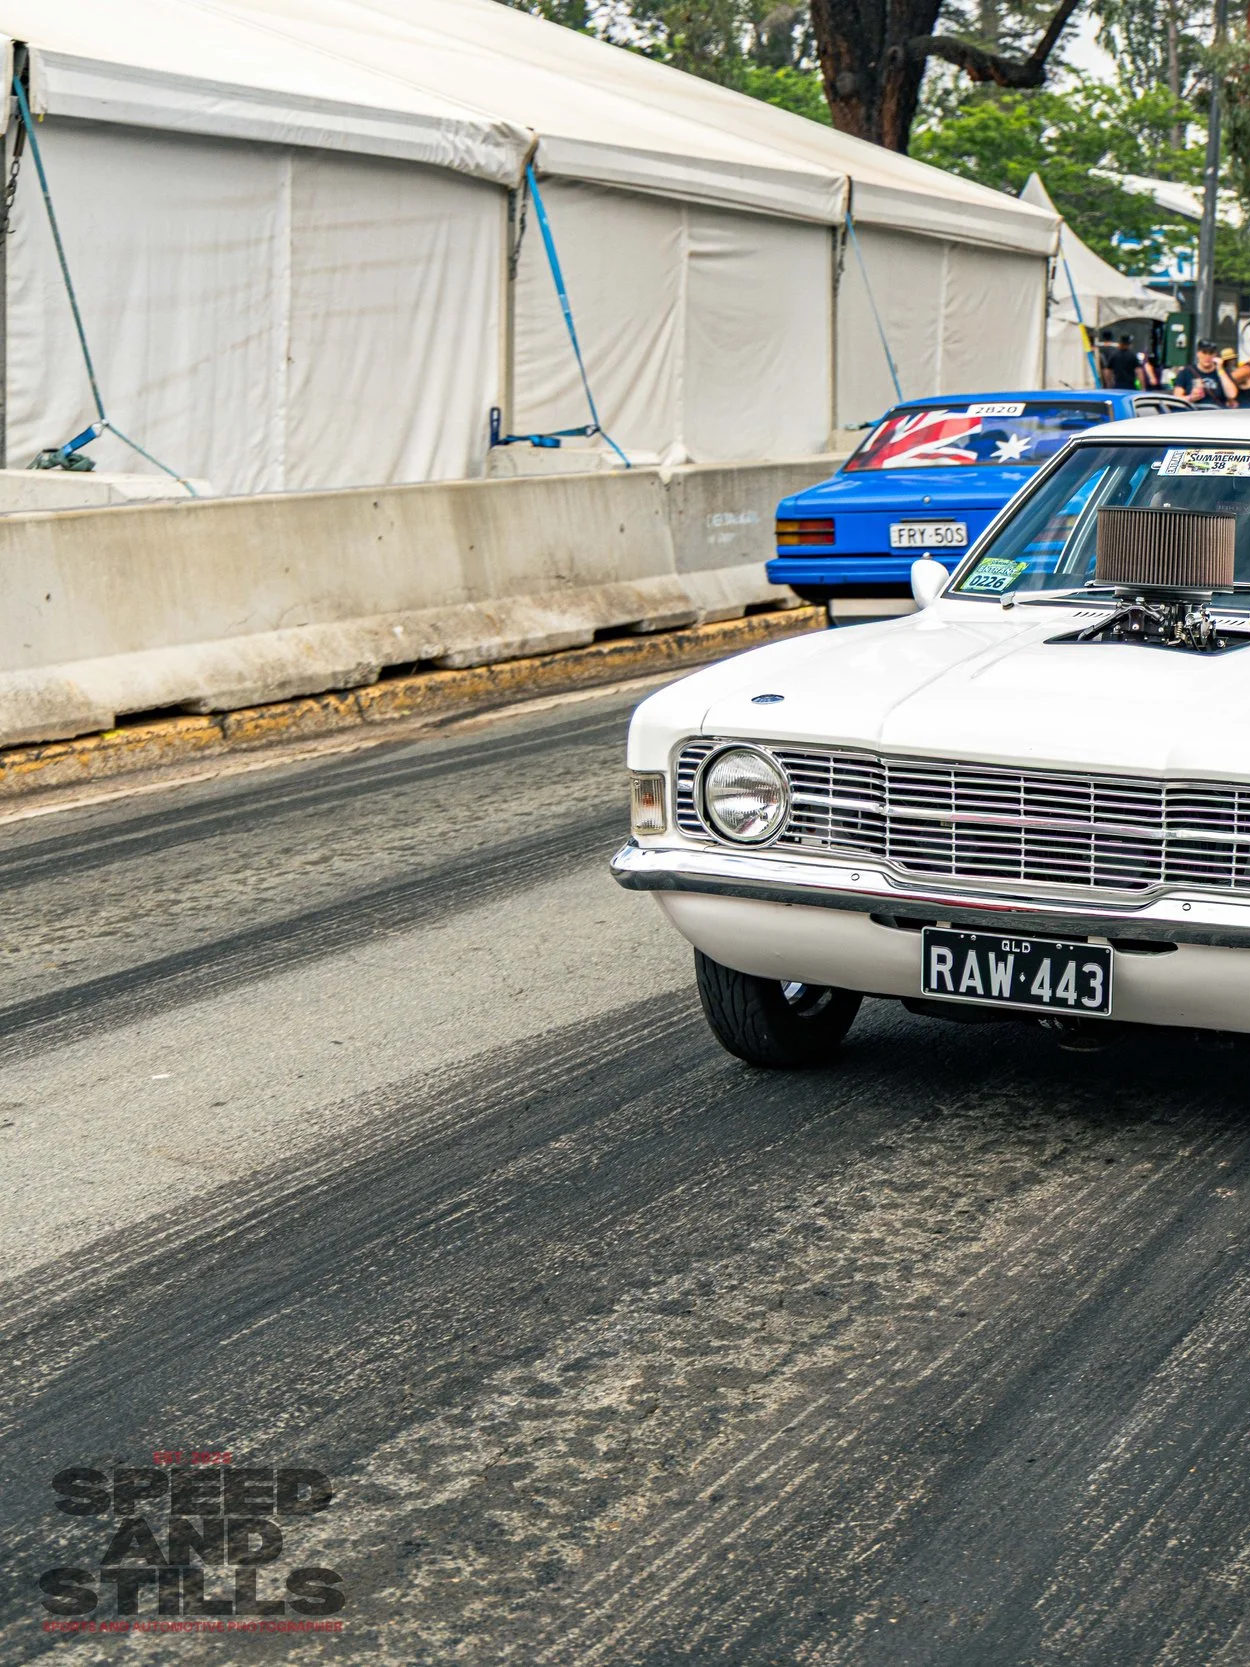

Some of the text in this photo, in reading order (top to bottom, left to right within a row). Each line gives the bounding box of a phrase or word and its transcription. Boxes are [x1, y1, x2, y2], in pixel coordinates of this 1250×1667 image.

[1211, 461, 1226, 470] 38
[968, 575, 1007, 589] 0226
[1001, 940, 1031, 953] QLD
